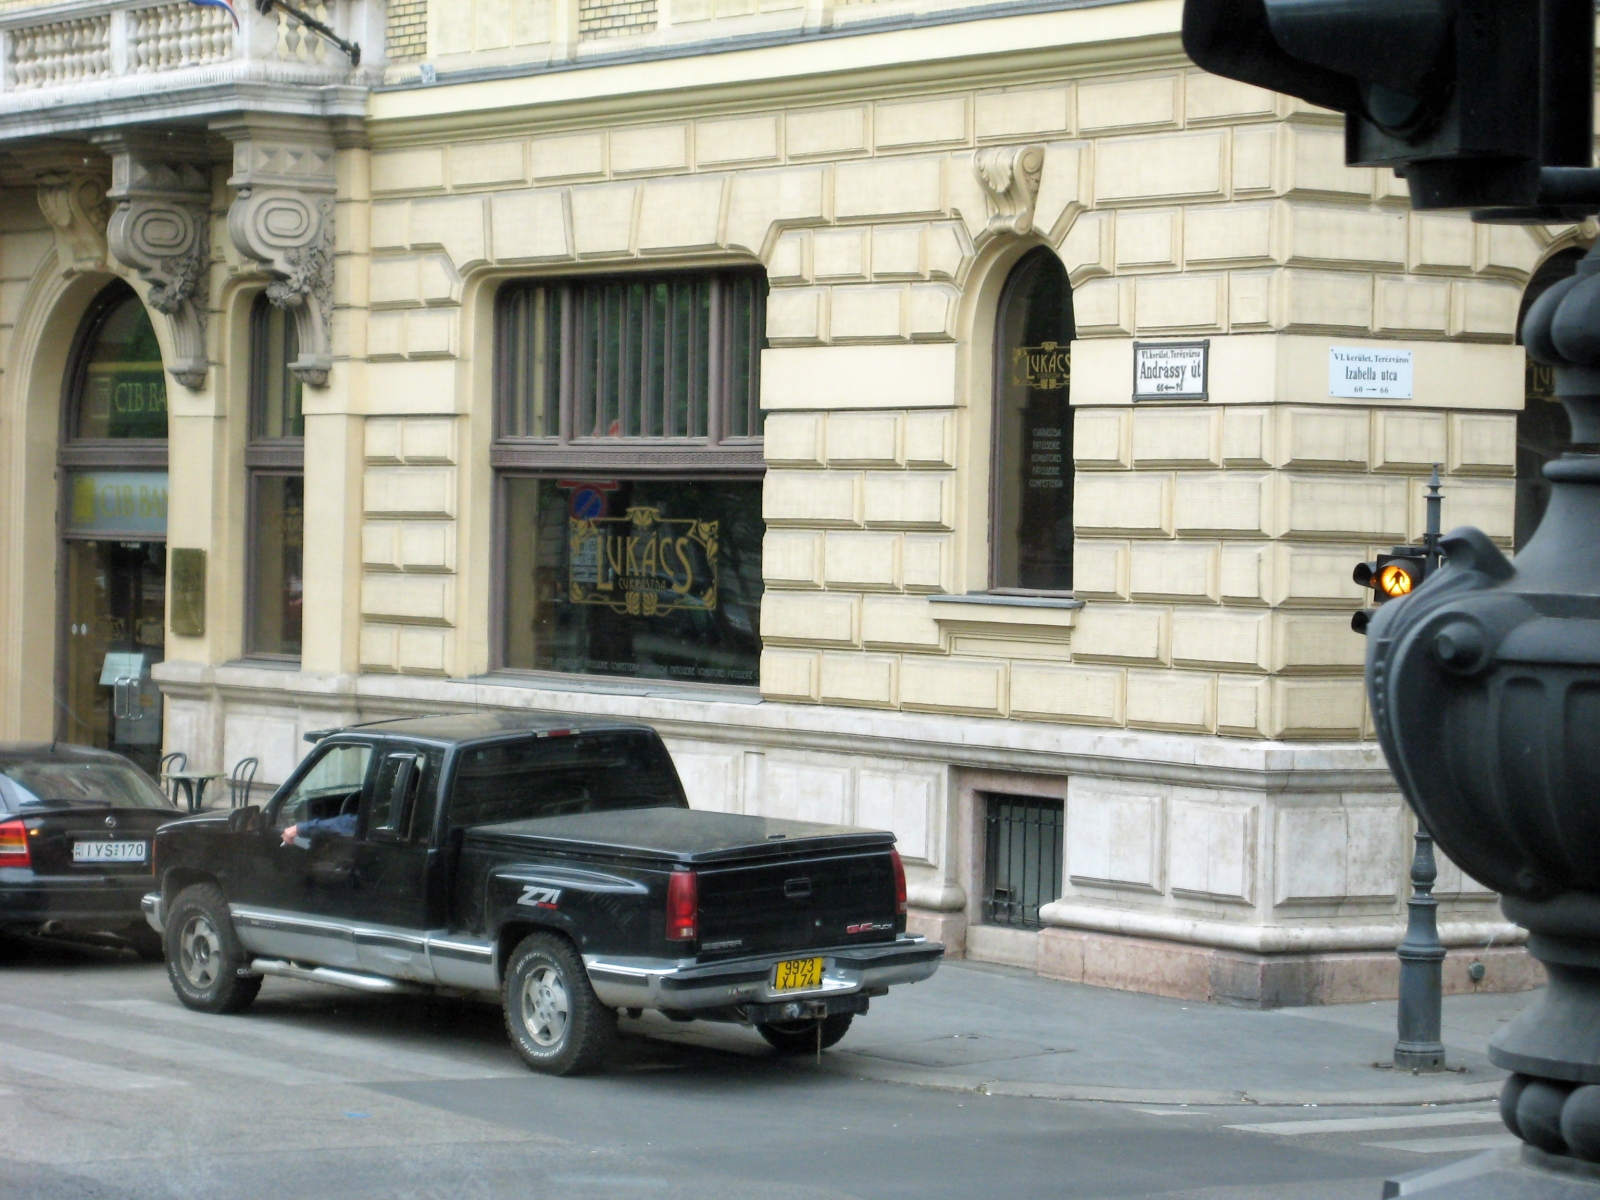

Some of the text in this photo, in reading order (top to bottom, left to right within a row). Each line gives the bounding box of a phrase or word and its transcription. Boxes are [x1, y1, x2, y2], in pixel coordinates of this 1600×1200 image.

[1026, 351, 1071, 379] LUKÁCS
[1346, 354, 1373, 363] kerület,
[1374, 355, 1410, 363] Terézváros
[1140, 360, 1201, 385] Andrássy út
[1345, 366, 1398, 381] Izabella utca
[115, 382, 145, 413] CIB
[100, 484, 135, 518] CIB
[596, 531, 693, 595] LUKÁCS
[516, 885, 562, 907] Z71
[784, 958, 815, 976] 9973
[781, 973, 814, 990] XJ 74
